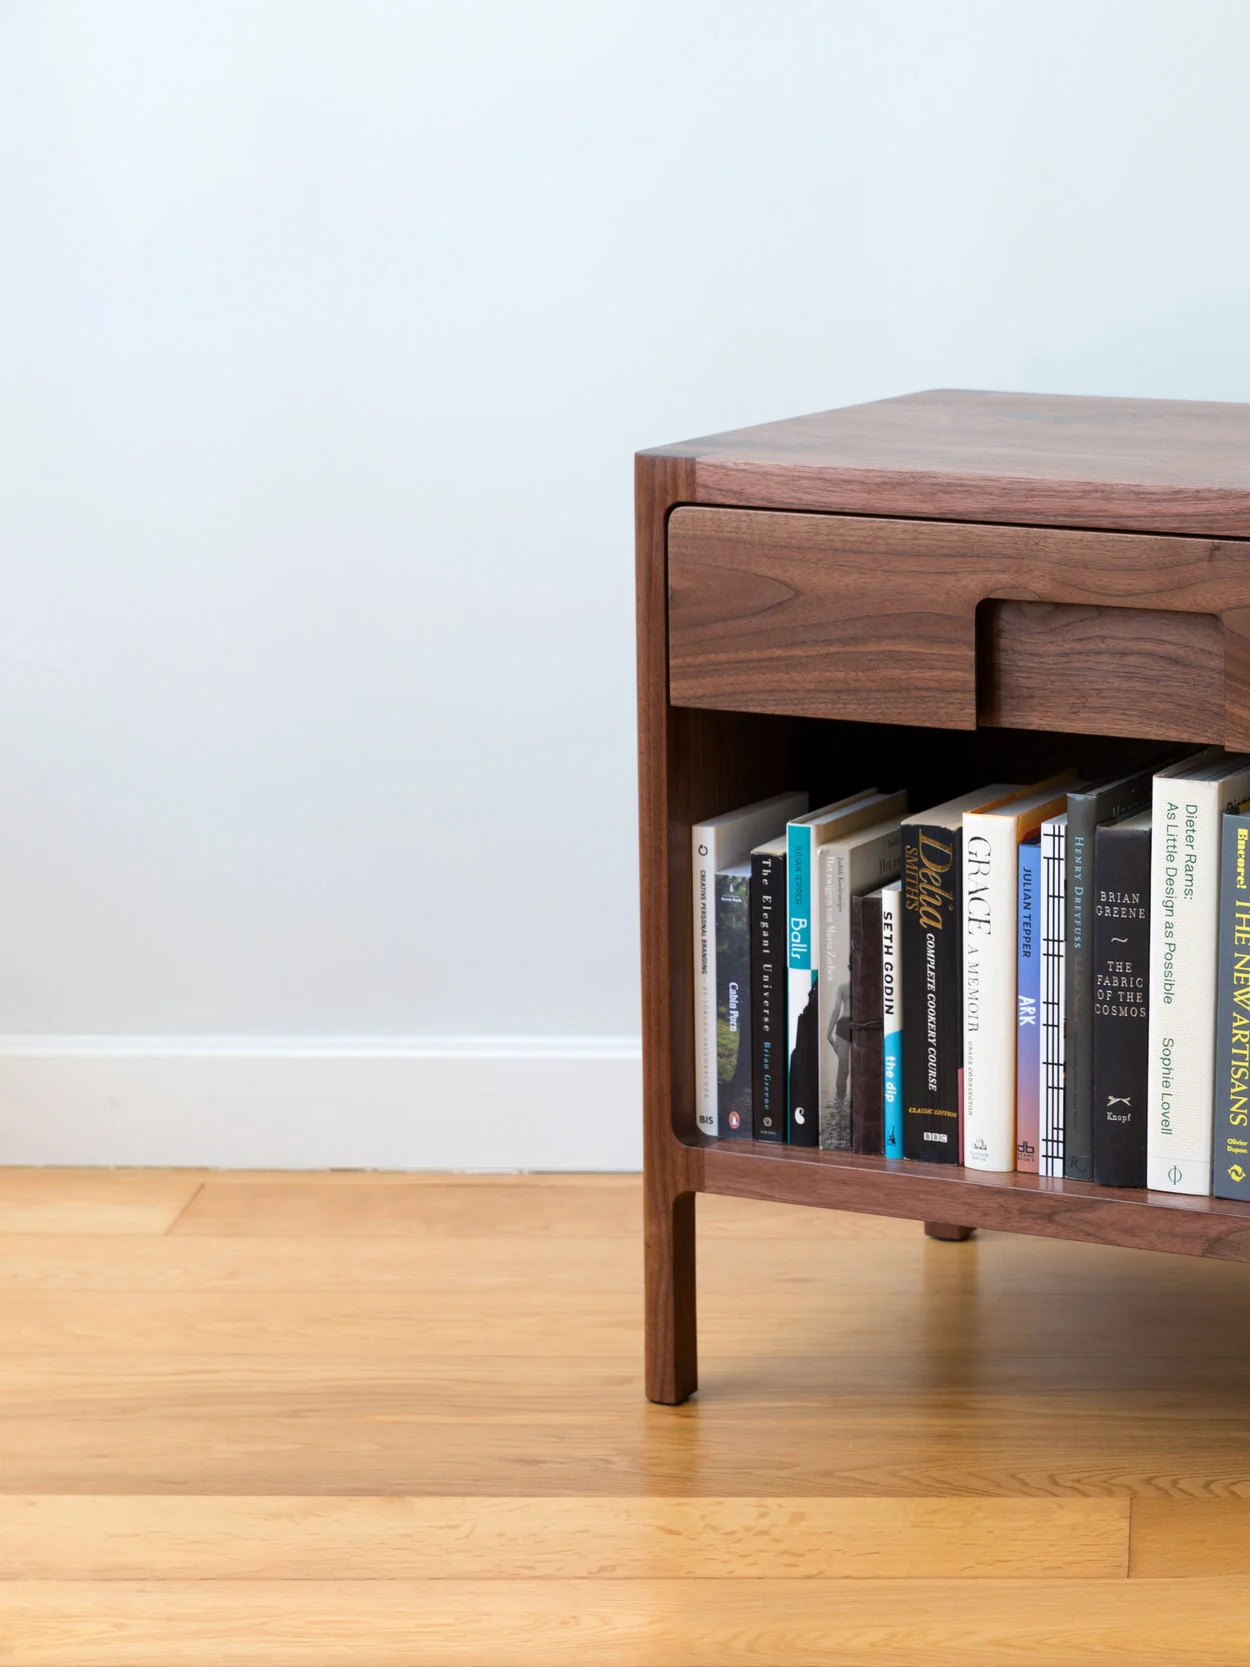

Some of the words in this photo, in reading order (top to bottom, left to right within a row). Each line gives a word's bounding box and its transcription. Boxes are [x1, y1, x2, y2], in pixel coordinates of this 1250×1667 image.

[1166, 801, 1179, 821] As
[1185, 803, 1198, 851] Dieter
[1073, 836, 1085, 881] HENRY
[1166, 824, 1179, 863] Little
[1236, 827, 1249, 890] Encore!
[761, 858, 772, 886] The
[918, 828, 955, 930] Delia
[967, 836, 992, 936] GRACE
[1023, 867, 1033, 911] JULIAN
[1161, 866, 1178, 918] Design
[1183, 853, 1198, 901] Rams:
[1073, 886, 1085, 949] DREYFUSS
[1095, 905, 1147, 919] GREENE
[1099, 890, 1140, 904] BRIAN
[760, 895, 772, 954] Elegant
[791, 917, 808, 960] Balls
[883, 911, 893, 956] SETH
[1022, 914, 1032, 958] TEPPER
[1163, 921, 1174, 939] as
[926, 932, 936, 992] COMPLETE
[967, 944, 979, 955] A
[1106, 961, 1133, 973] THE
[884, 961, 894, 1016] GODIN
[1096, 974, 1144, 988] FABRIC
[1162, 942, 1177, 1005] Possible
[729, 982, 740, 1009] Cabin
[762, 963, 773, 1032] Universe
[967, 961, 980, 1033] MEMOIR
[1018, 995, 1037, 1026] ARK
[1094, 1003, 1147, 1018] COSMOS
[1097, 989, 1113, 1001] OF
[1117, 991, 1144, 1003] THE
[729, 1010, 739, 1032] Porn
[926, 993, 937, 1046] COOKERY
[763, 1041, 772, 1070] Brian
[885, 1055, 897, 1078] the
[927, 1047, 938, 1092] COURSE
[1159, 1037, 1175, 1089] Sophie
[1228, 1011, 1250, 1128] ARTISANS
[763, 1074, 772, 1110] Greene
[885, 1081, 897, 1103] dip
[908, 1107, 934, 1115] CLASSIC
[934, 1109, 958, 1118] EDITION
[1106, 1111, 1132, 1124] Knopf
[1160, 1092, 1174, 1135] Lovell
[923, 1132, 948, 1143] BBC
[1226, 1137, 1248, 1146] Olivier
[1226, 1145, 1248, 1155] Dupon
